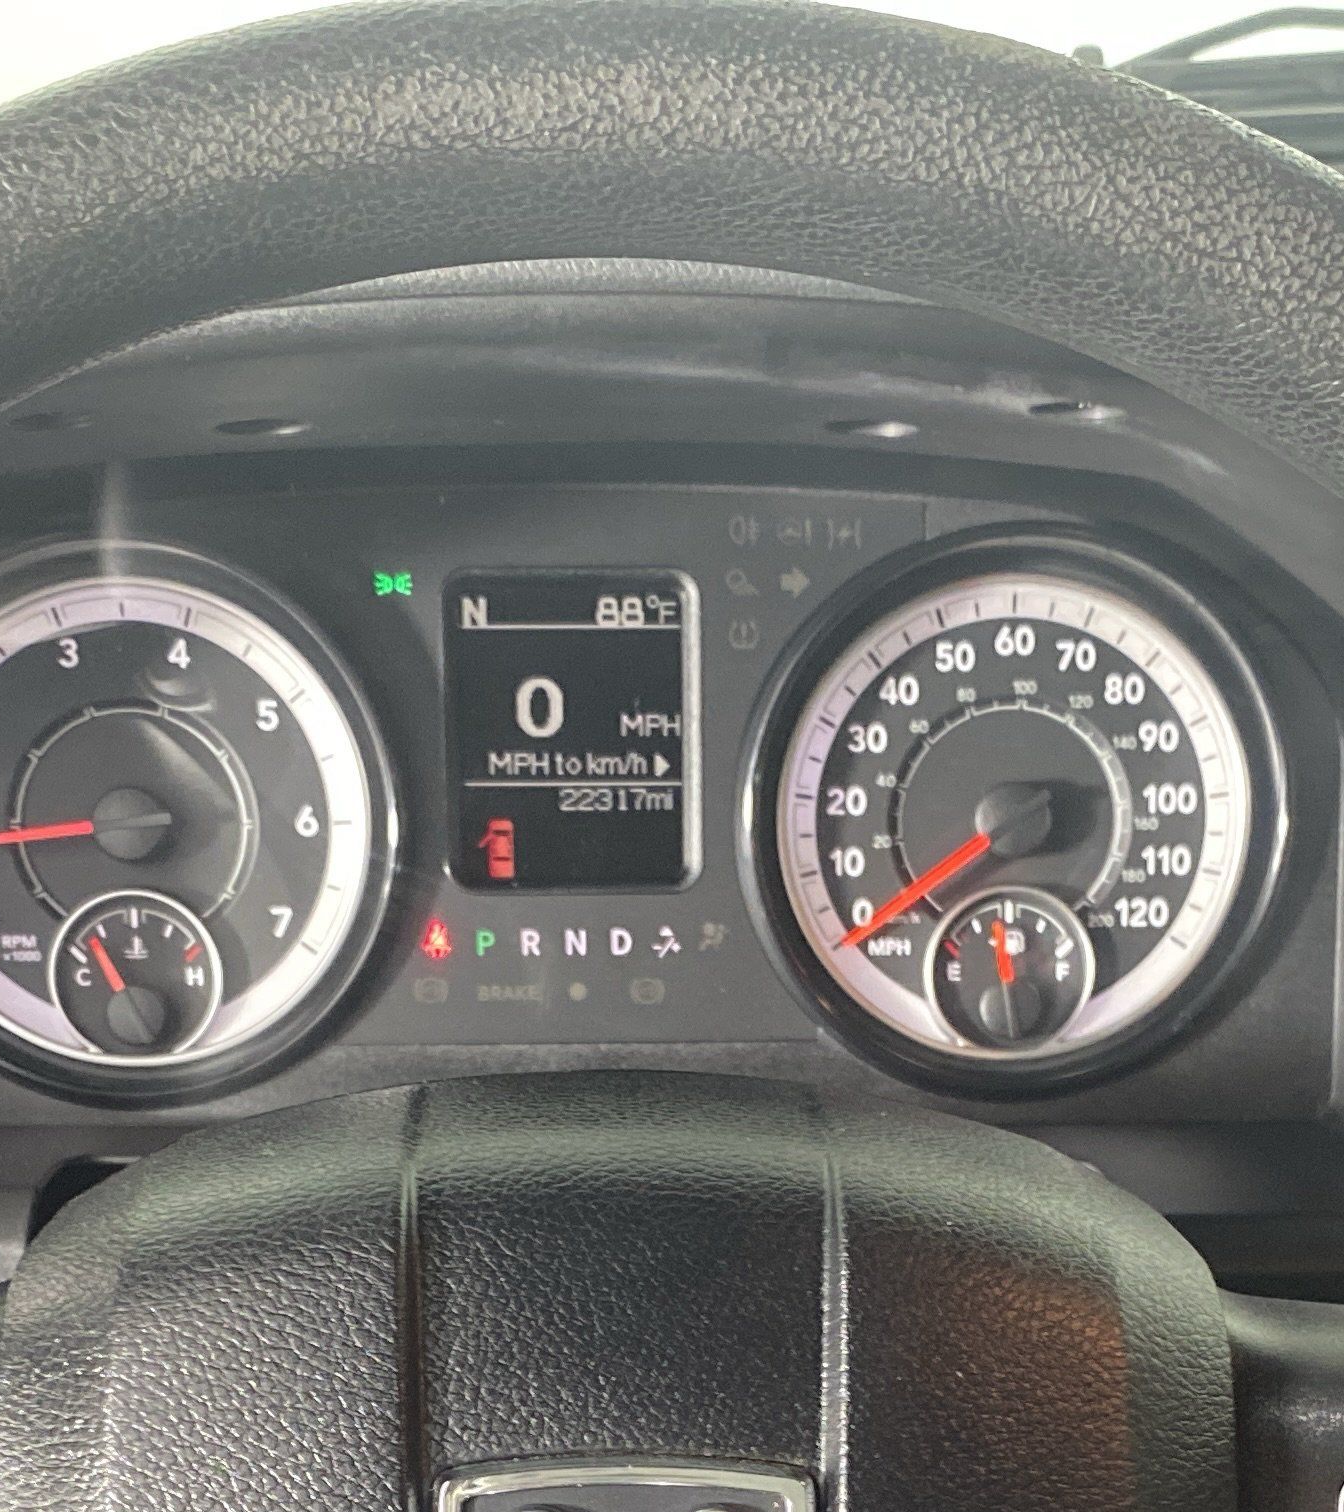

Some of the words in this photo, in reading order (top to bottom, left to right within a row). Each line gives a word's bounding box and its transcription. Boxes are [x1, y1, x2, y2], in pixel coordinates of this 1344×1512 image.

[461, 596, 488, 628] N
[58, 640, 80, 669] 3
[167, 639, 191, 669] 4
[994, 625, 1036, 656] 60
[935, 643, 975, 673] 50
[1056, 642, 1096, 672] 70
[880, 676, 920, 706] 40
[1012, 680, 1038, 695] 100
[1069, 694, 1094, 710] 120
[1104, 673, 1145, 705] 80
[256, 701, 279, 731] 5
[516, 675, 565, 738] 0
[620, 713, 680, 736] MPH
[847, 723, 888, 754] 30
[1138, 720, 1179, 753] 90
[488, 753, 550, 776] MPH
[557, 752, 581, 774] to
[586, 752, 647, 776] km/h
[559, 789, 674, 812] 22317mi
[826, 786, 868, 816] 20
[1143, 783, 1198, 814] 100
[294, 805, 318, 837] 6
[829, 847, 865, 877] 10
[1142, 844, 1192, 875] 110
[270, 906, 293, 936] 7
[852, 897, 873, 927] 0
[1114, 898, 1170, 928] 120
[1, 934, 37, 949] RPM
[475, 928, 496, 957] P
[520, 927, 542, 957] R
[564, 927, 588, 957] N
[609, 927, 633, 956] D
[867, 936, 912, 957] MPH
[75, 968, 93, 988] C
[185, 968, 204, 988] H
[947, 963, 961, 983] E
[1055, 962, 1071, 982] F
[477, 984, 539, 1002] BRAKE
